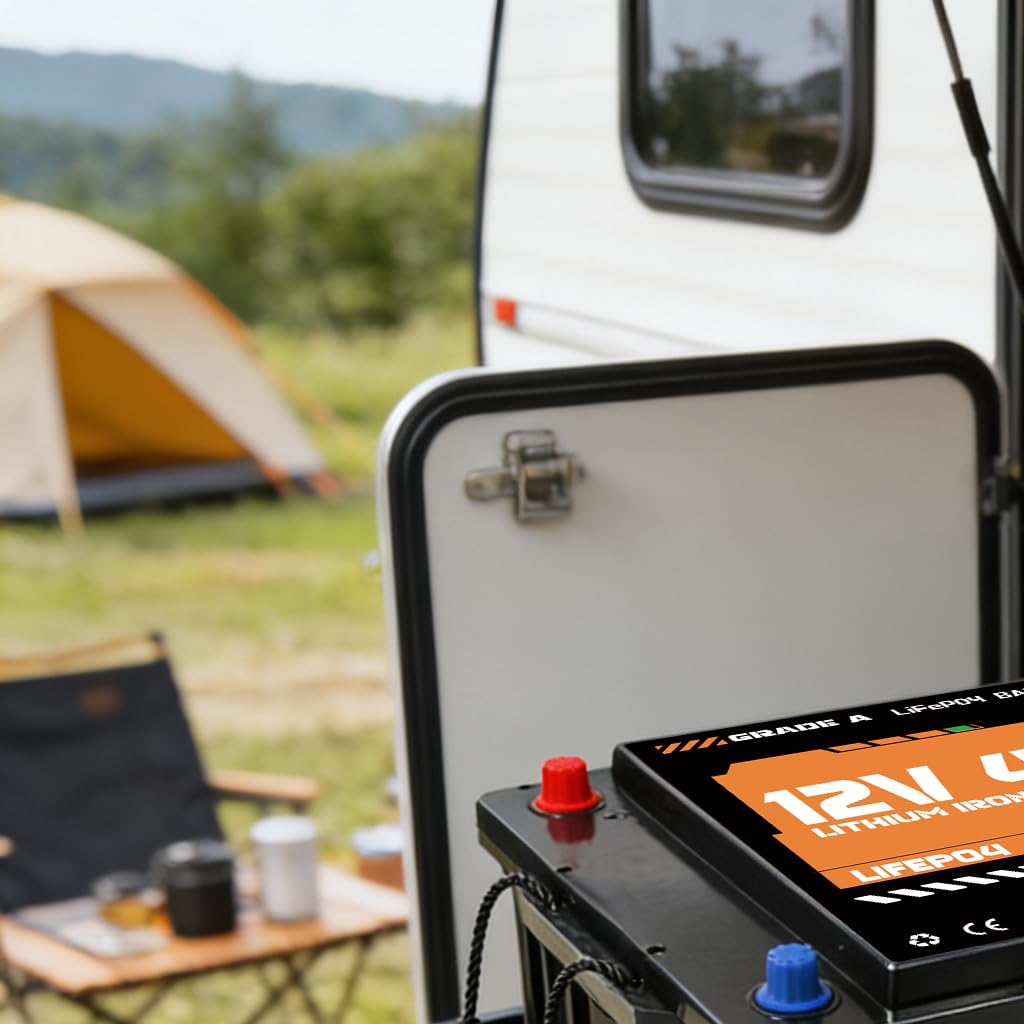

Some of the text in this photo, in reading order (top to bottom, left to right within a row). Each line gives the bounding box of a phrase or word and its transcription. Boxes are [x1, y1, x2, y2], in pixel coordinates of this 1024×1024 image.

[728, 718, 840, 742] GRADE
[848, 713, 873, 724] A
[764, 765, 955, 826] 12V
[810, 806, 949, 839] LITHIUM
[849, 843, 1013, 883] LIFEPO4
